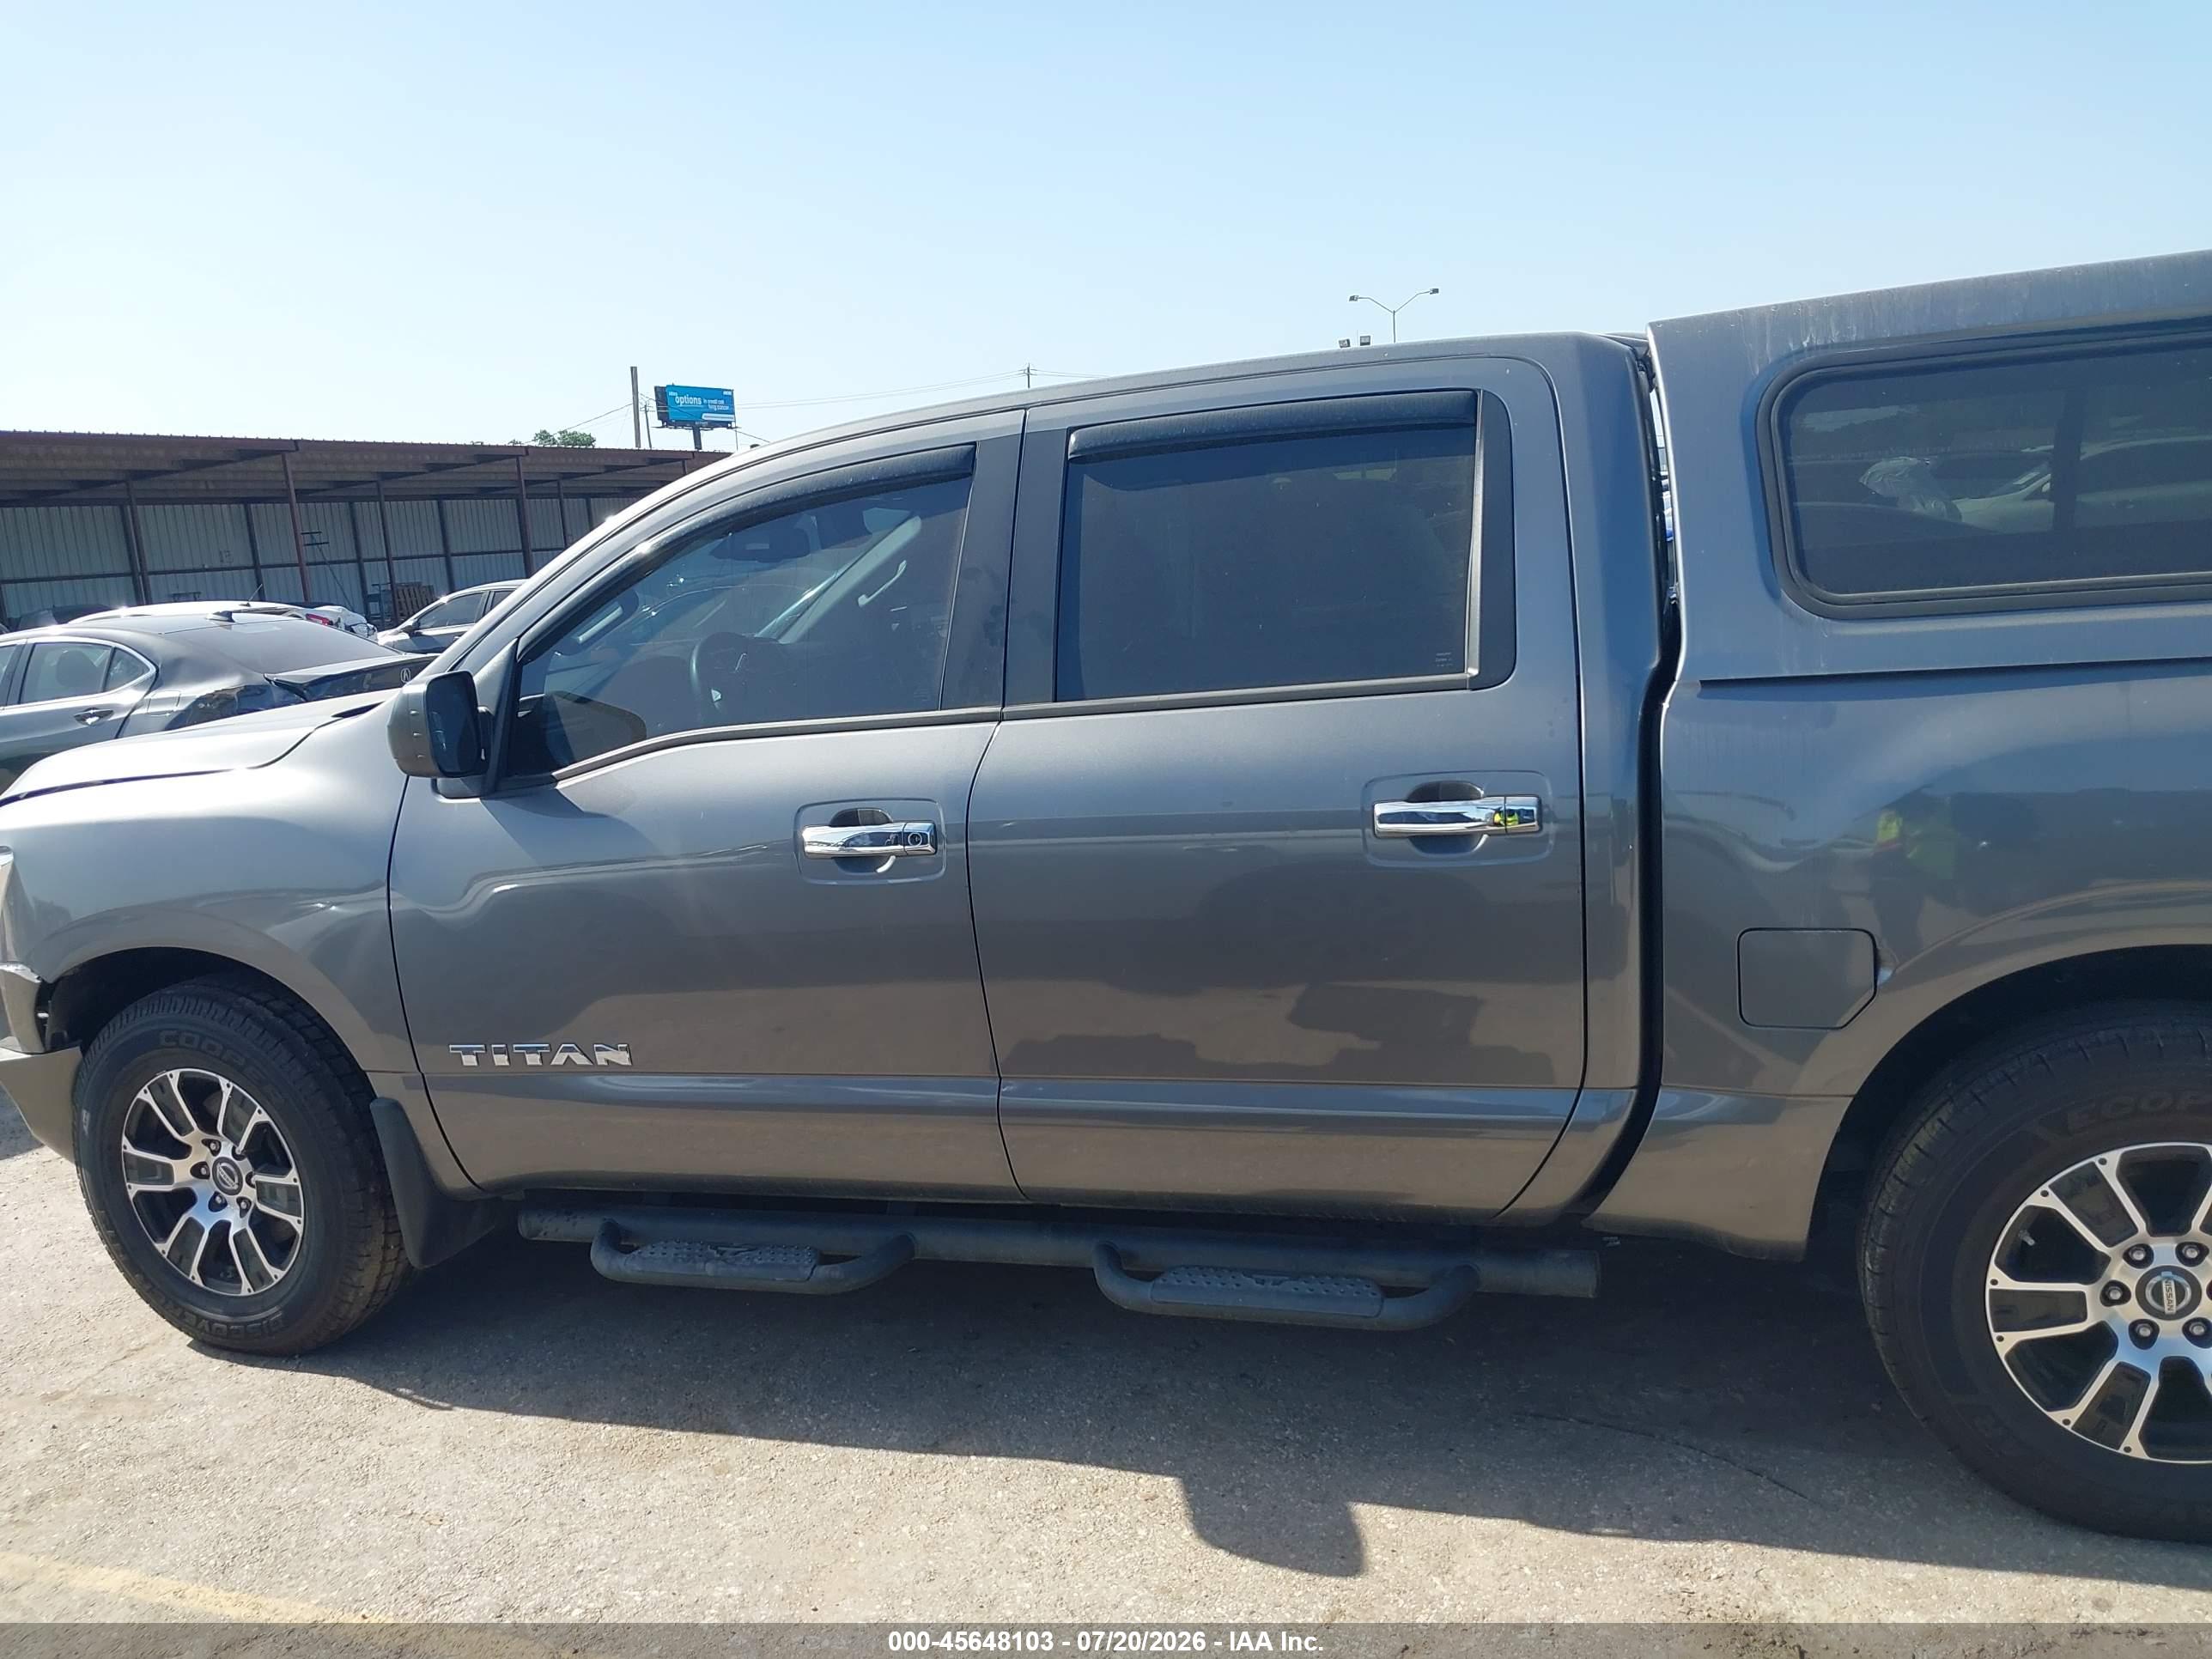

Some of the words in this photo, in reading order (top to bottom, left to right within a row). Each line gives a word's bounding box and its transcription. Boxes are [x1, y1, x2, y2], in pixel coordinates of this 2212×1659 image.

[675, 394, 702, 407] options
[448, 1043, 632, 1066] TITAN
[2164, 1278, 2175, 1311] NISSAN
